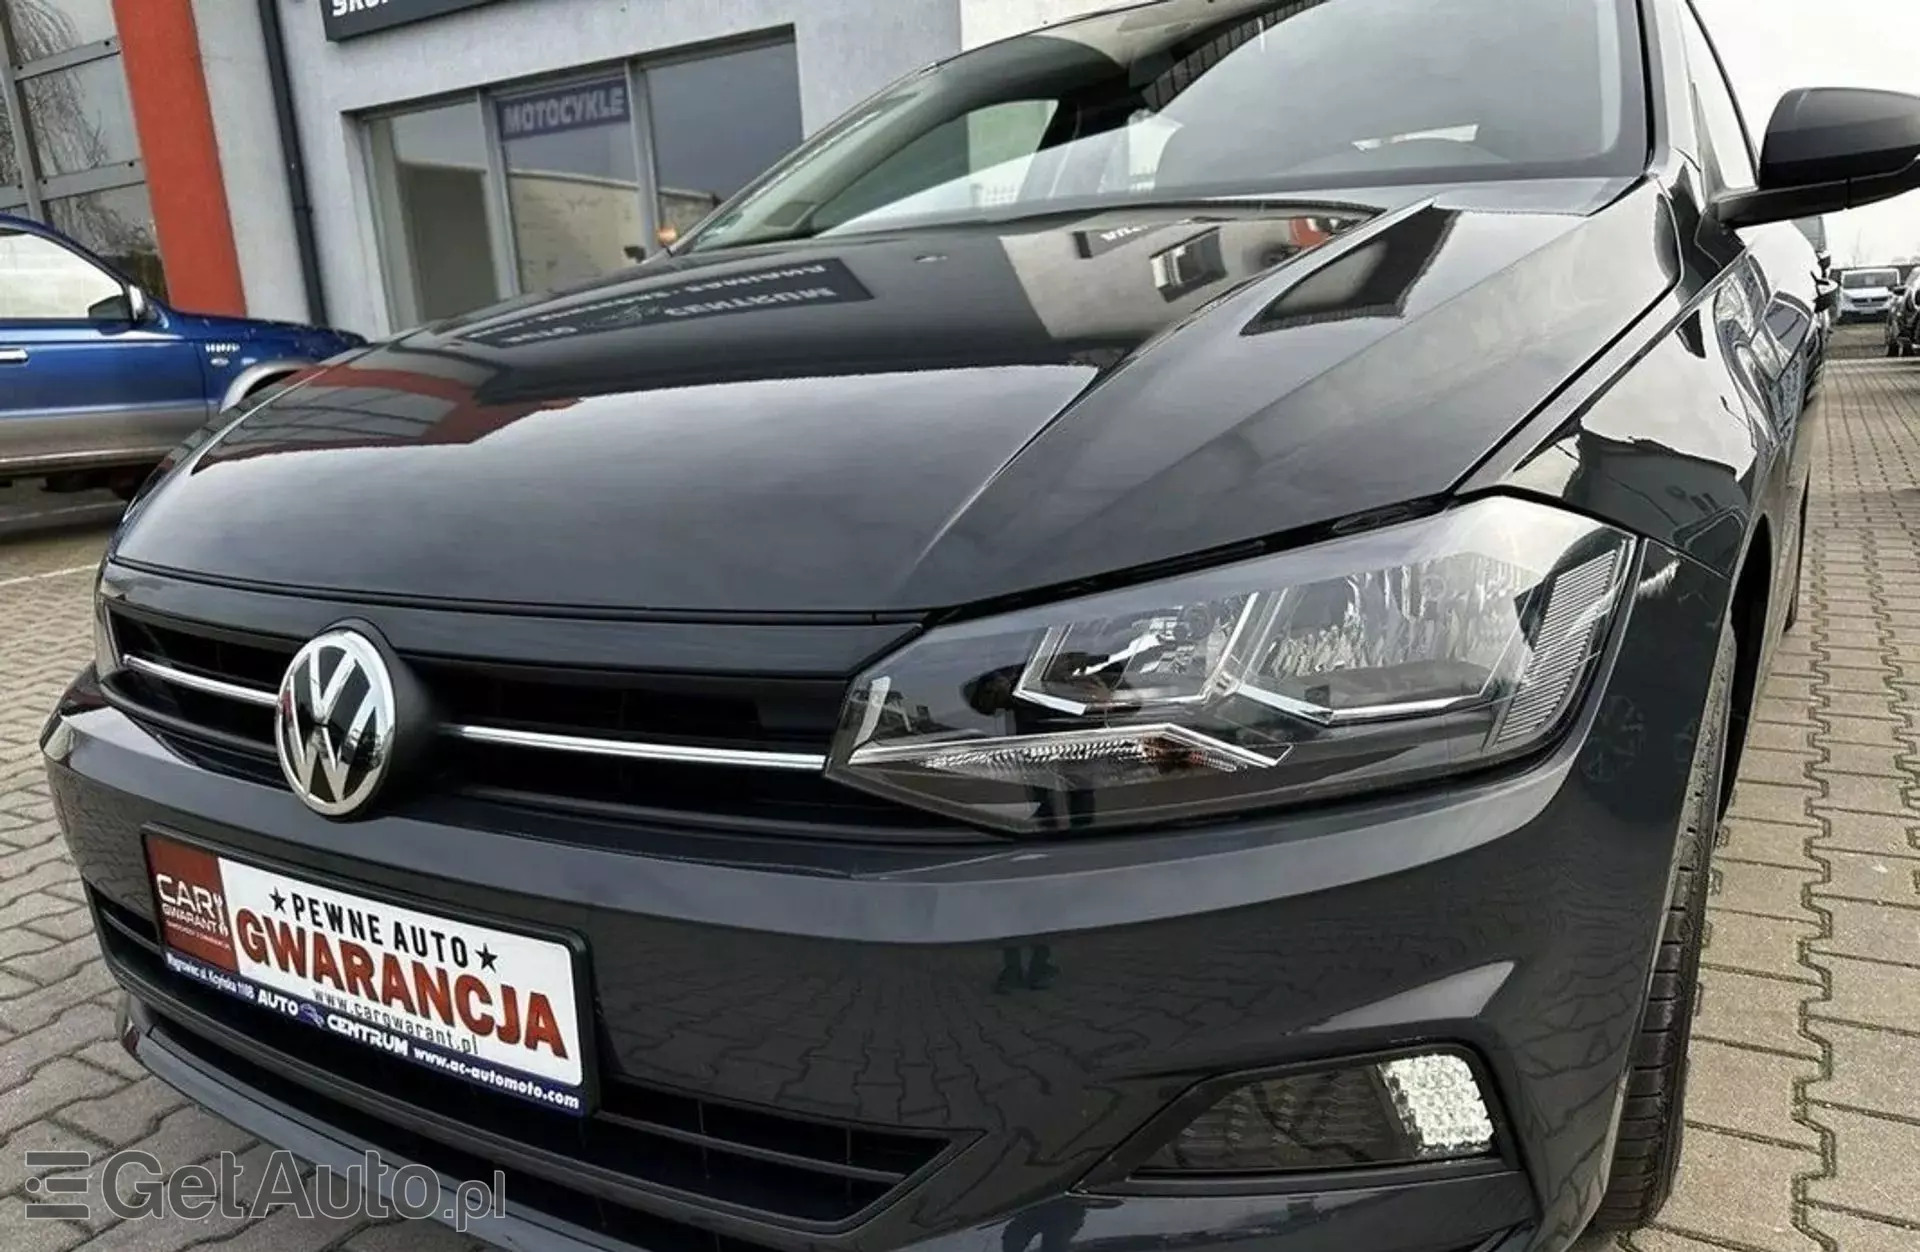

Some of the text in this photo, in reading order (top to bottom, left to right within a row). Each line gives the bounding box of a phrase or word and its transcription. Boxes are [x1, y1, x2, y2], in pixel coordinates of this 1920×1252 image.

[503, 87, 625, 134] MOTOCYKLE
[291, 893, 384, 945] PEWNE
[394, 921, 468, 968] AUTO
[236, 908, 568, 1059] GWARANCJA
[312, 987, 478, 1055] www.cargwarant.pl
[258, 989, 580, 1109] AUTO CENTRUM www.ac-automoto.com
